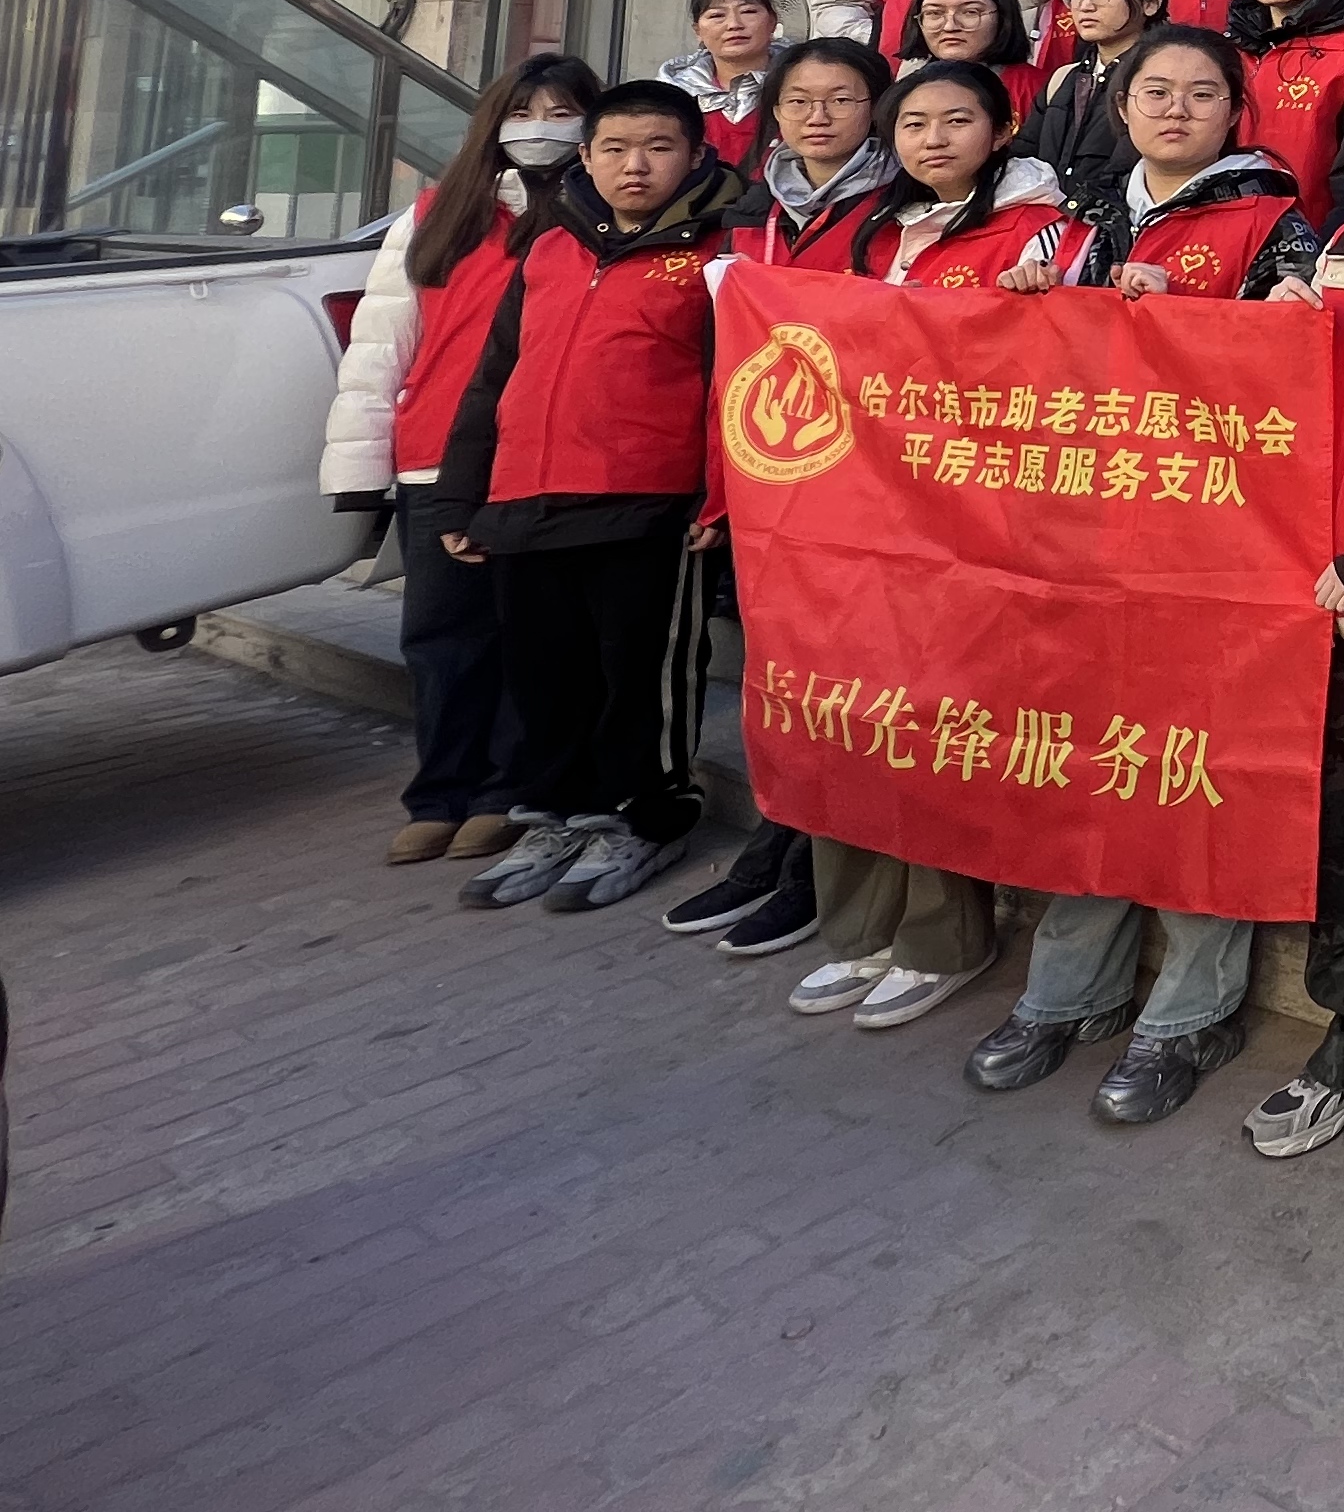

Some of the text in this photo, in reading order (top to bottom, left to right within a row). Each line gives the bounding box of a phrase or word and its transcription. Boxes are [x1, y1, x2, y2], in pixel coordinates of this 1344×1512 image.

[858, 372, 1298, 456] 哈尔滨市助老志愿者协会
[899, 432, 1247, 507] 平房志愿服务支队
[750, 659, 1224, 809] 青团先锋服务队
